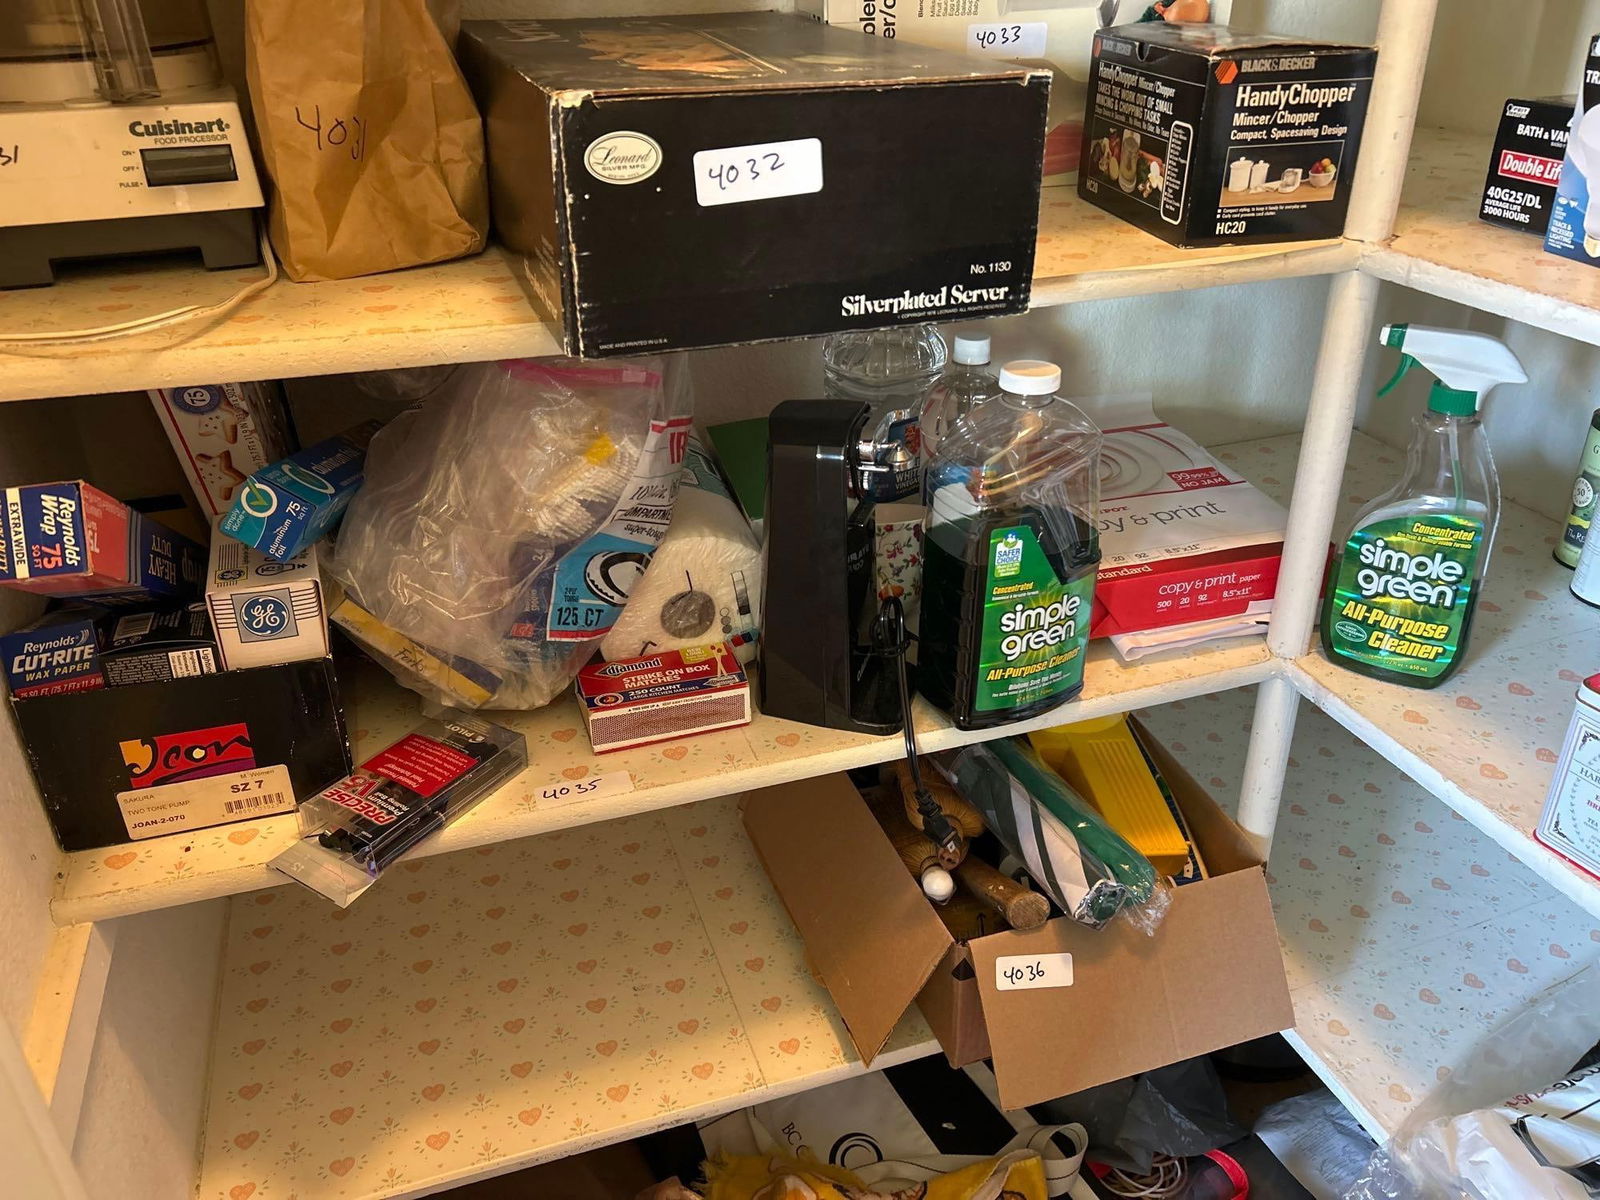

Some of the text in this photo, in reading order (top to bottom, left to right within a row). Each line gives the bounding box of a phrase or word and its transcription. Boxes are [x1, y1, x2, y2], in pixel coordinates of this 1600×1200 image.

[976, 25, 1021, 48] 4033
[1236, 83, 1355, 110] HandyChopper
[1143, 108, 1161, 125] TASKS
[1155, 99, 1173, 115] SMALL
[129, 118, 225, 138] Cuisinart
[1232, 110, 1319, 127] Mincer/Chopper
[154, 133, 228, 145] FOOD PROCESSOR
[1230, 124, 1347, 141] Compact, Spacesaving Design
[1516, 124, 1544, 138] BATH
[1543, 131, 1549, 140] &
[709, 152, 785, 190] 4032
[1503, 154, 1544, 177] Double
[1485, 199, 1522, 212] AVERAGE LIFE
[1487, 186, 1542, 209] 40G25/DL
[1483, 205, 1530, 223] 3000 HOURS
[1215, 220, 1246, 235] HC20
[969, 261, 1011, 275] No. 1130
[841, 284, 1009, 317] Silverplated Server
[1200, 477, 1226, 487] JAM
[40, 493, 57, 536] Wrap
[286, 501, 301, 517] 75
[301, 506, 309, 515] ft
[224, 508, 240, 531] simply
[1130, 514, 1148, 526] &
[9, 502, 26, 565] EXTRA WIDE
[59, 496, 81, 566] Reynolds
[269, 519, 292, 554] aluminum
[1412, 522, 1475, 542] Concentrated
[41, 543, 63, 570] 75
[274, 545, 287, 558] foil
[996, 555, 1020, 565] CHOICE
[997, 548, 1021, 557] SAFER
[1359, 539, 1463, 582] simple
[33, 558, 42, 569] FT
[992, 582, 1034, 595] Concentrated
[1158, 572, 1261, 595] copy & print paper
[1357, 569, 1455, 607] green
[1156, 600, 1172, 608] 500
[1180, 597, 1190, 605] 20
[1197, 593, 1208, 602] 92
[557, 606, 604, 627] 125 CT
[1001, 593, 1080, 632] simple
[1342, 600, 1449, 639] All-Purpose
[24, 635, 75, 653] Reynolds
[1001, 619, 1075, 661] green
[1367, 631, 1444, 660] Cleaner
[12, 643, 95, 674] CUT-RITE
[606, 657, 662, 677] diamond
[987, 647, 1081, 681] All-Purpose Cleaner
[25, 661, 91, 682] WAX PAPER
[623, 664, 711, 685] STRIKE ON BOX
[625, 675, 681, 689] MATCHES
[628, 684, 681, 696] 250 COUNT
[629, 686, 700, 701] LARGE KITCHEN MATCHES
[444, 724, 475, 739] PILOT
[249, 769, 275, 778] Women
[230, 780, 265, 794] SZ 7
[543, 779, 602, 799] 4035
[123, 793, 154, 804] SAKURA
[127, 799, 190, 816] TWO TONE PUMP
[320, 789, 397, 825] PRECISE
[367, 794, 404, 817] Premium
[131, 814, 186, 829] JOAN-2-070
[1004, 961, 1045, 985] 4036
